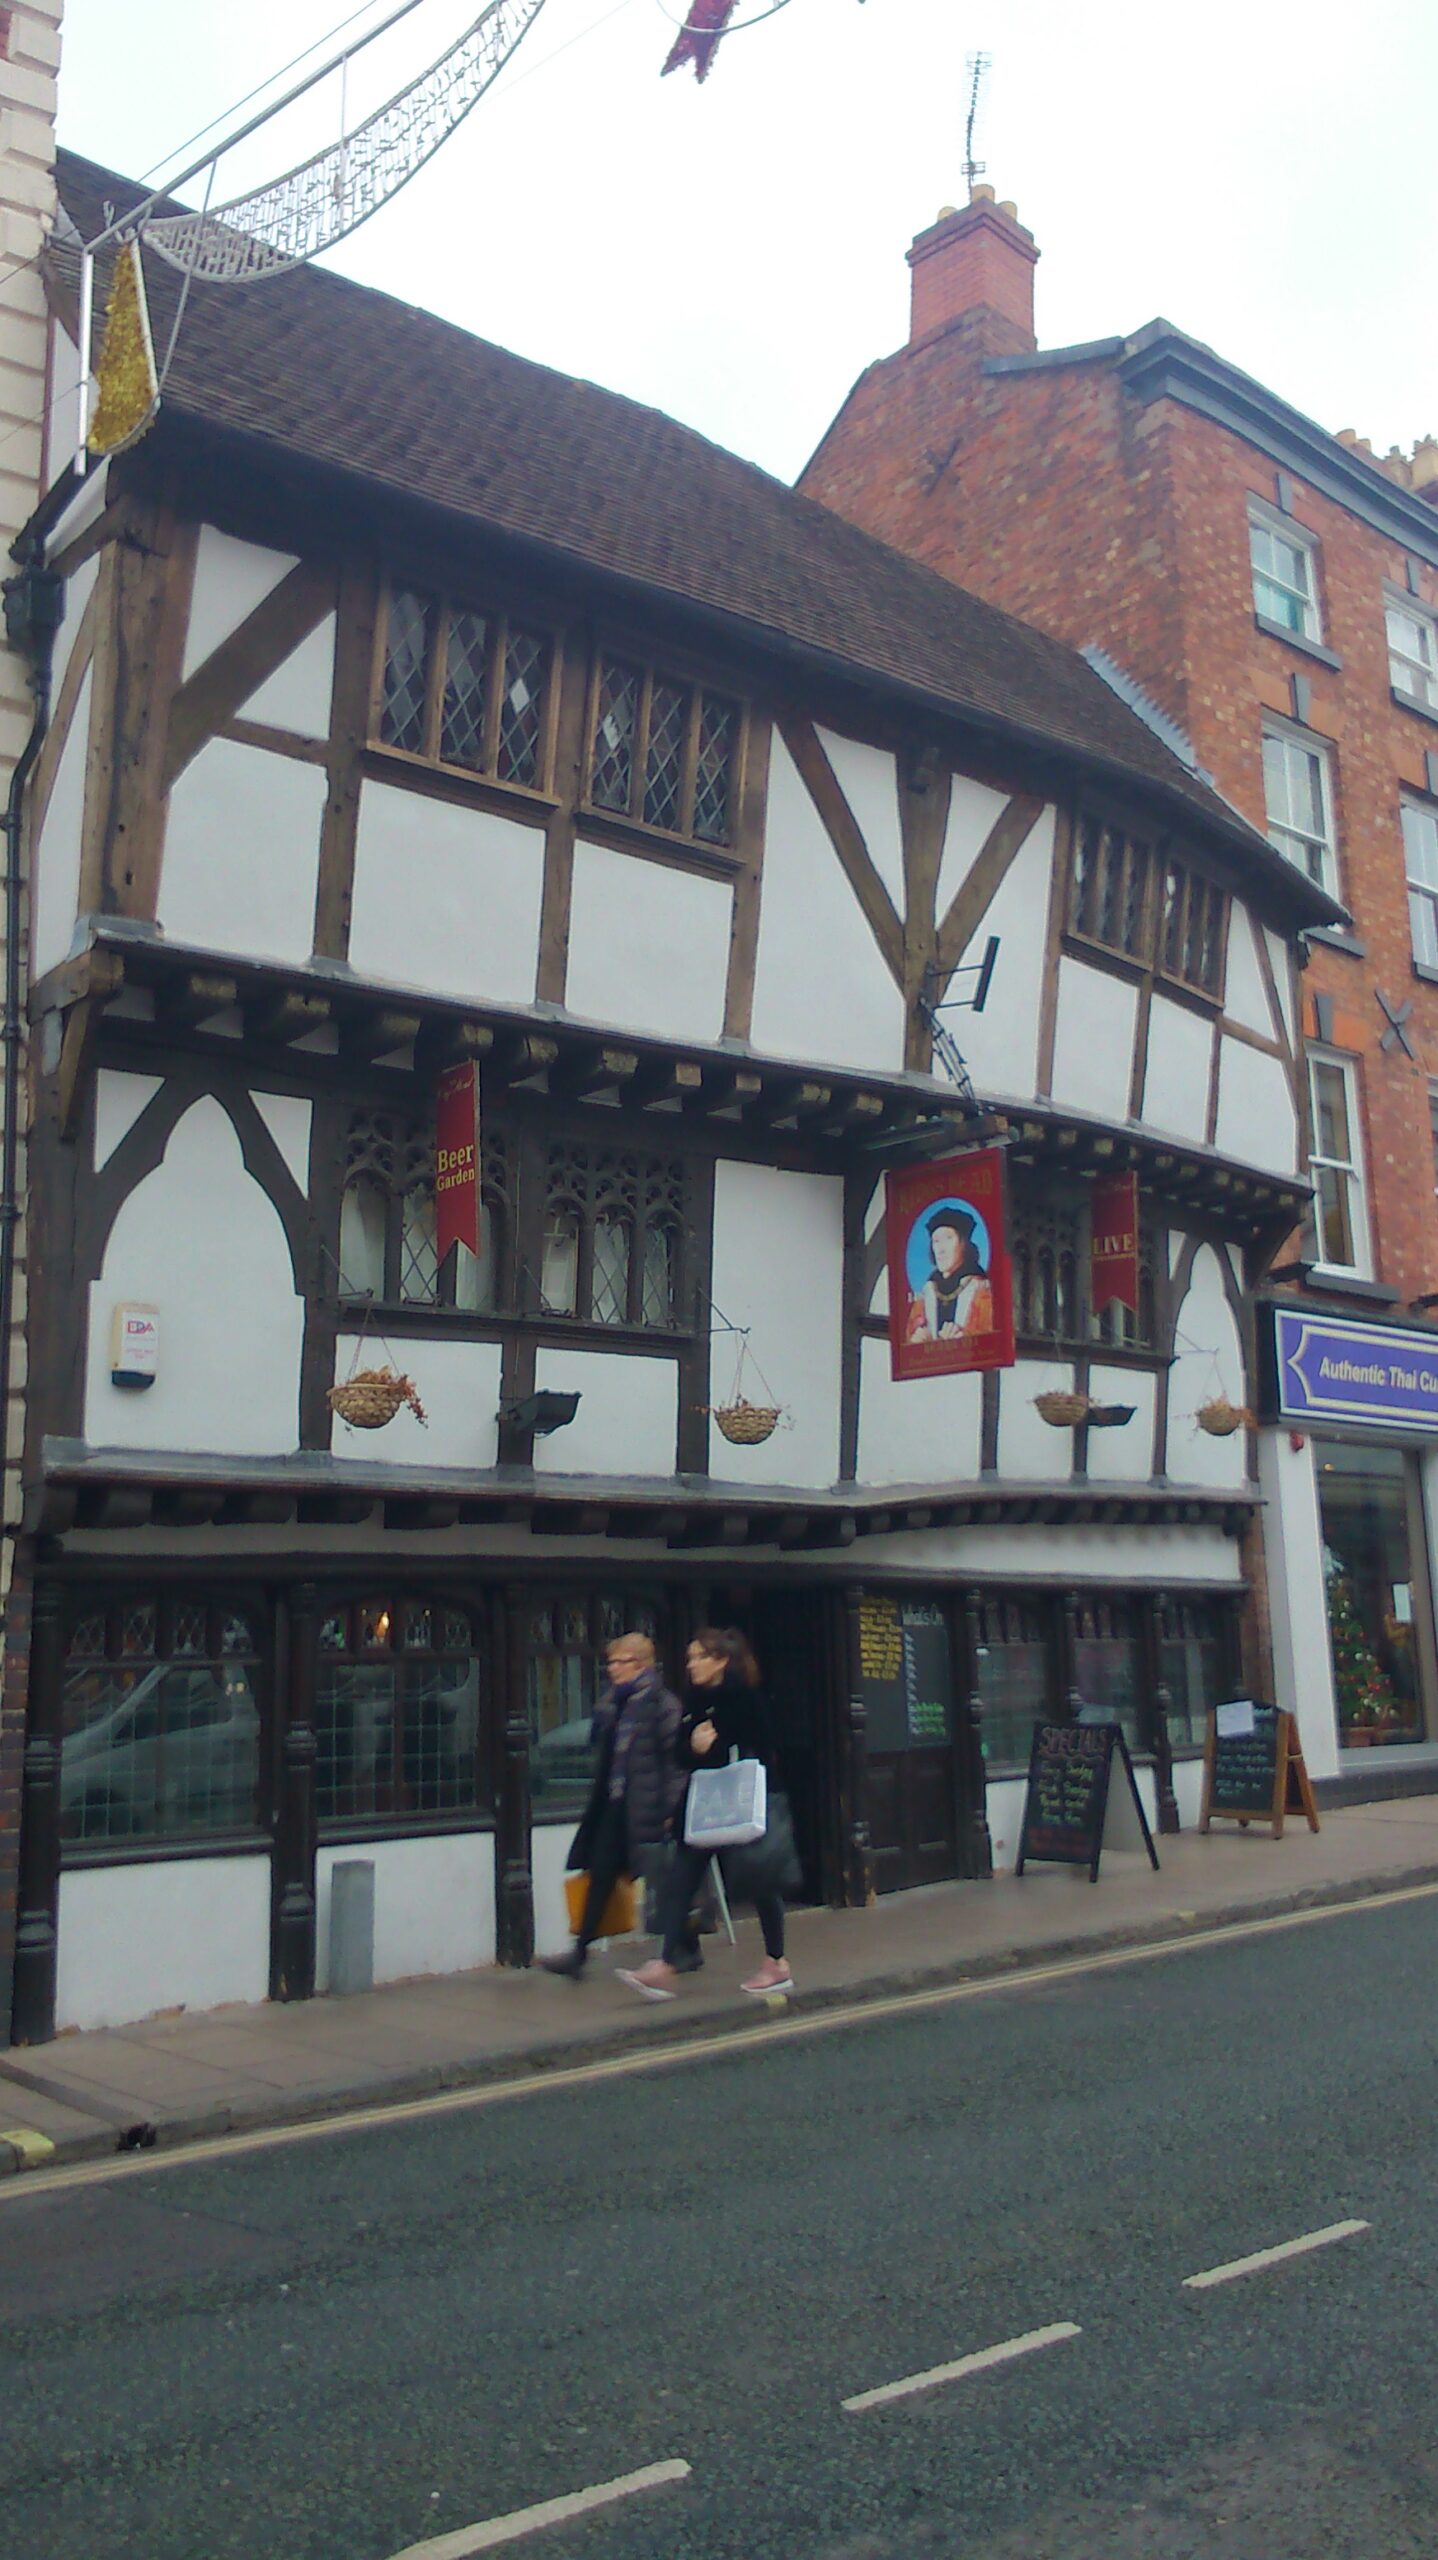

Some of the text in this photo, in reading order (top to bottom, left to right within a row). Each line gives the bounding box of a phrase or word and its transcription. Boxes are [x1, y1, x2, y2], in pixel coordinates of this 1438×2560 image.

[438, 1144, 474, 1172] Beer
[436, 1168, 475, 1192] Garden
[1093, 1233, 1134, 1254] LIVE
[1319, 1356, 1385, 1386] Authentic
[1389, 1366, 1416, 1390] Thai
